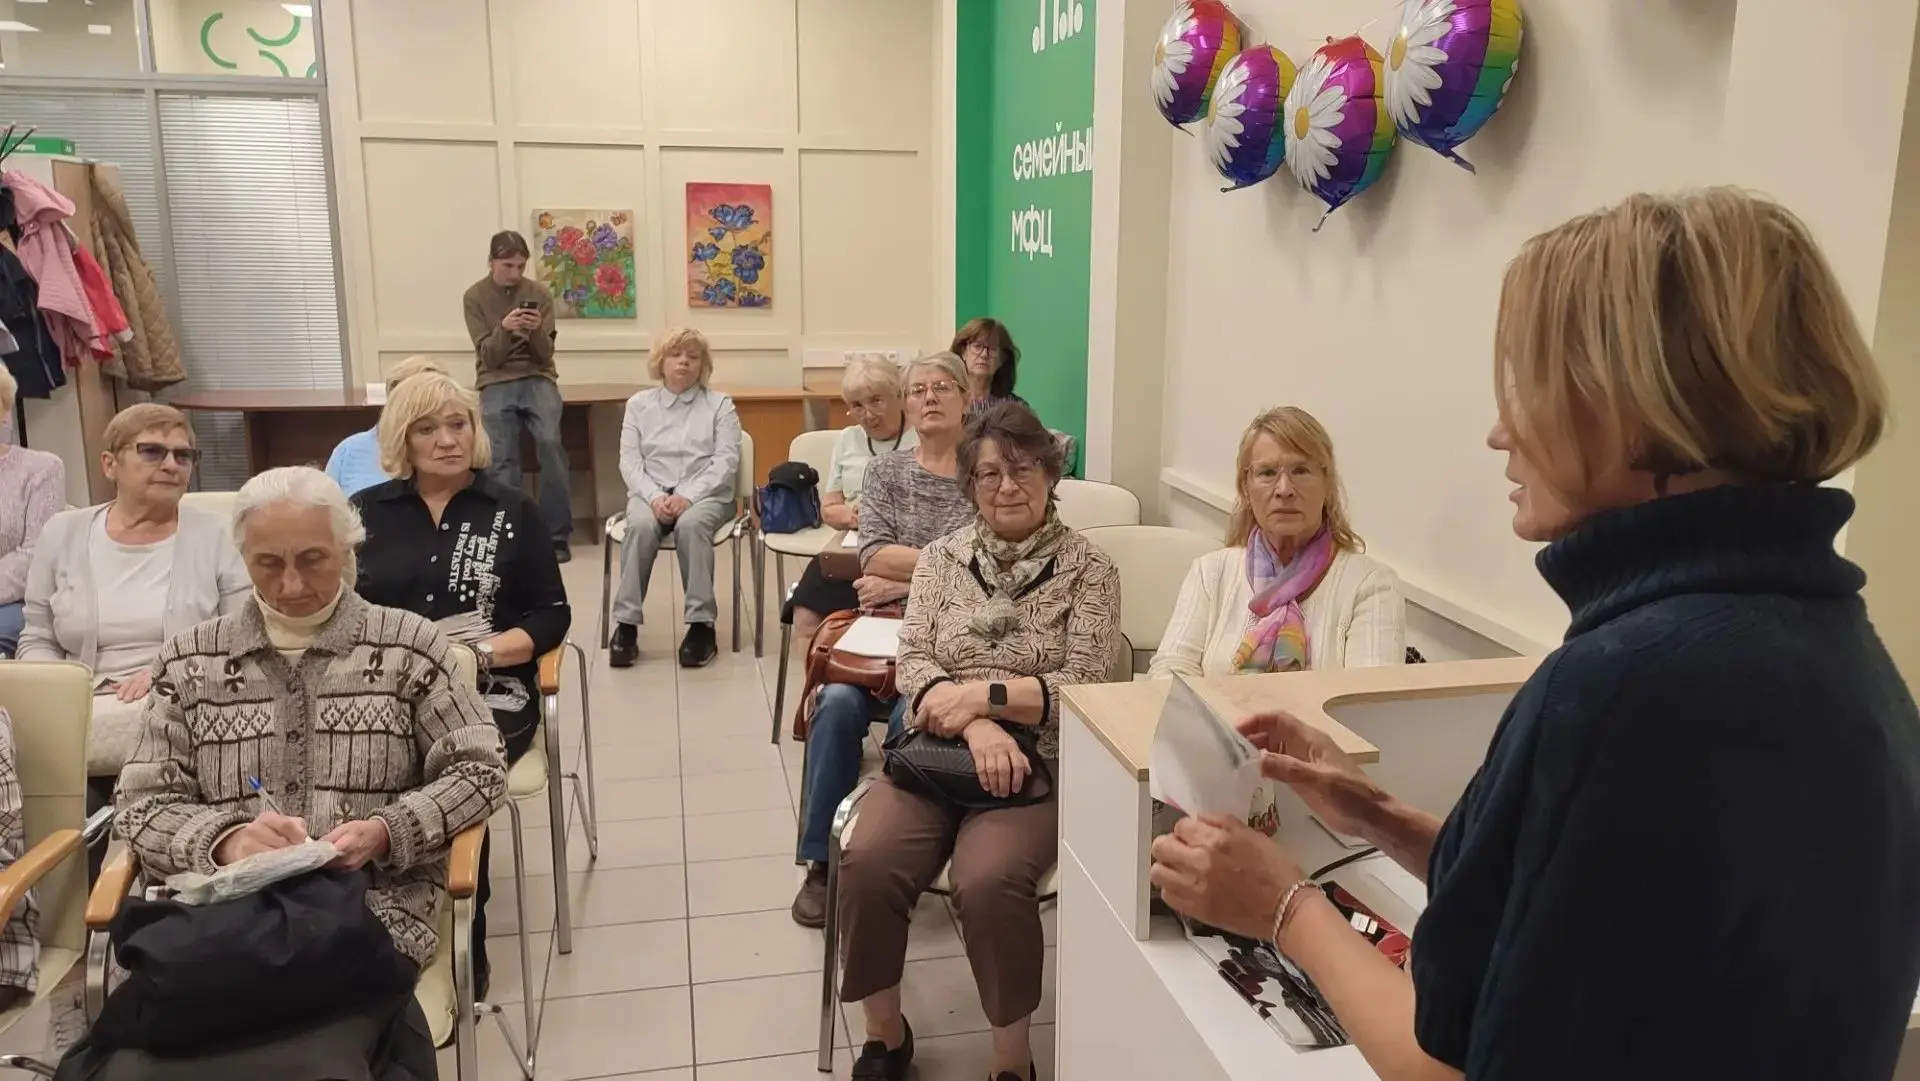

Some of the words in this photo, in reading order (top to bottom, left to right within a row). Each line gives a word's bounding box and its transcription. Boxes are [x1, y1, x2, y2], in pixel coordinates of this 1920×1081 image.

[1013, 121, 1093, 181] семейны
[461, 522, 471, 532] IS
[492, 510, 505, 532] YOU
[464, 534, 478, 557] very
[487, 531, 499, 553] ARE
[462, 557, 473, 581] cool
